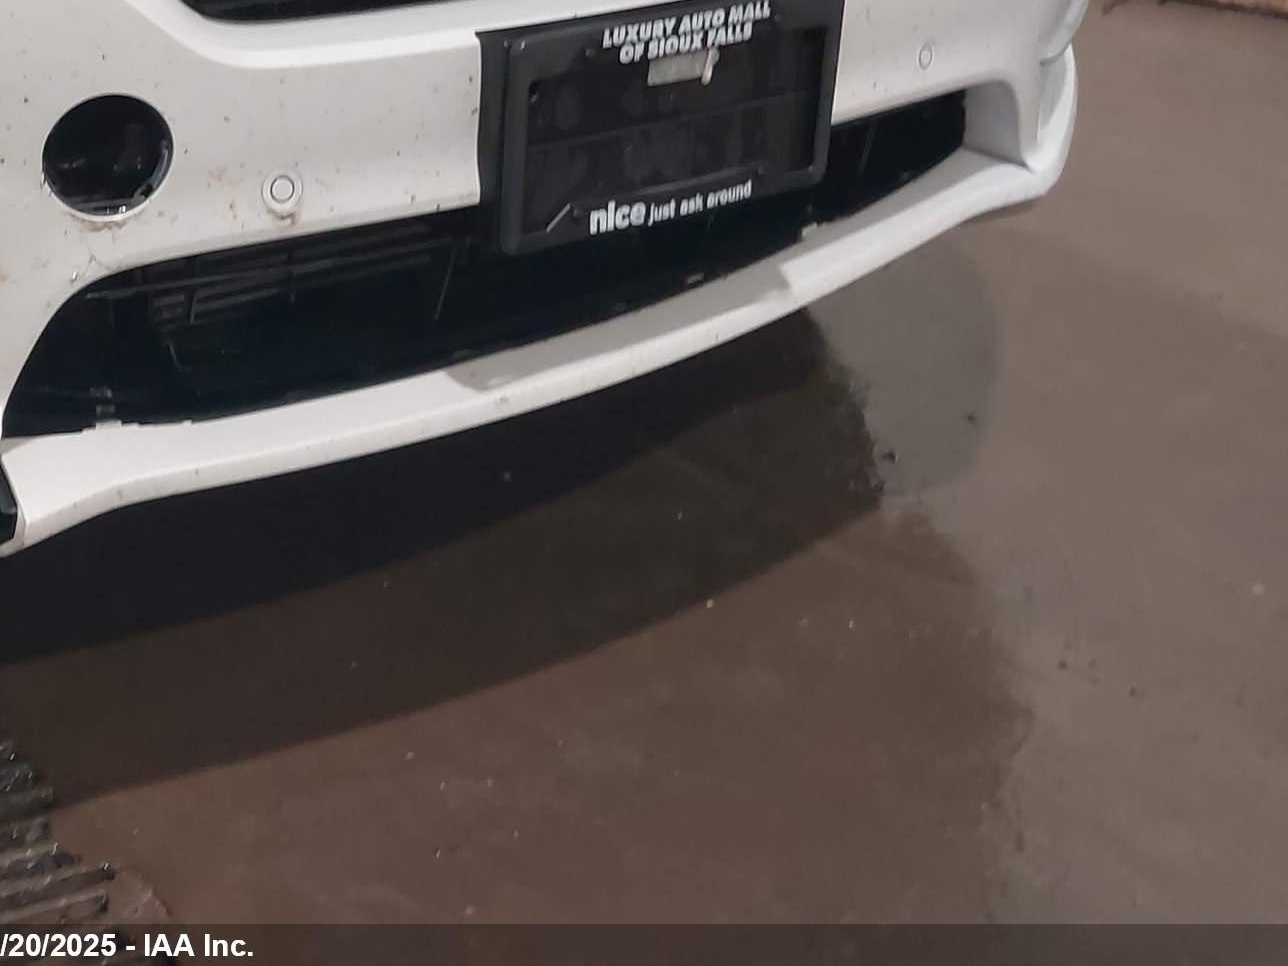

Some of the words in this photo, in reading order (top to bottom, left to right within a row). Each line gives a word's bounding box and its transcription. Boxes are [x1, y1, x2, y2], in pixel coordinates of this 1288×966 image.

[602, 18, 676, 49] LUXURY
[679, 8, 726, 33] AUTO
[728, 0, 771, 22] MALL
[619, 44, 646, 65] OF
[647, 33, 705, 60] SIOUX
[706, 22, 752, 47] FALLS
[589, 200, 646, 236] nice
[648, 198, 676, 227] just
[679, 192, 704, 217] ask
[706, 179, 753, 209] around
